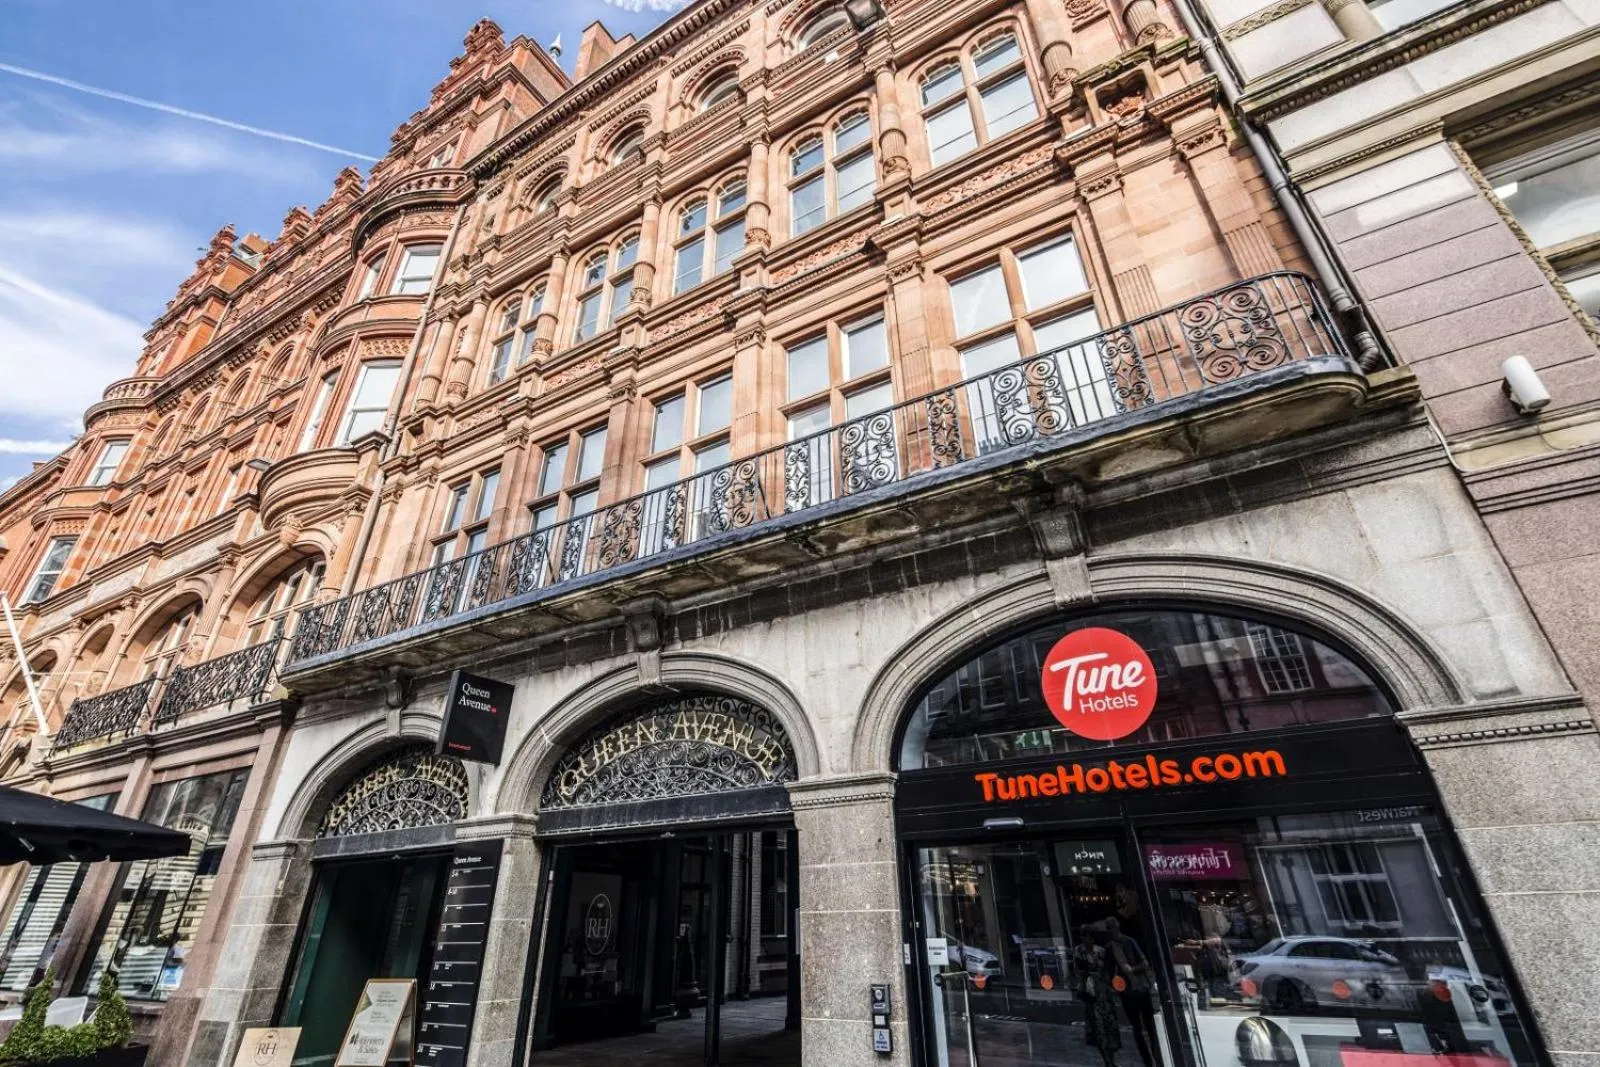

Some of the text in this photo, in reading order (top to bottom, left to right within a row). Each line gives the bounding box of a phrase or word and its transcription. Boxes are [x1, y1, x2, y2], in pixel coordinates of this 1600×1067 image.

[462, 682, 490, 699] Queen
[1049, 652, 1146, 711] Tune
[458, 695, 491, 712] Avenue
[1079, 692, 1139, 714] Hotels
[558, 711, 785, 798] QUEEN AVENUE
[974, 749, 1287, 803] TuneHotels.com
[587, 918, 609, 938] RH
[256, 1042, 277, 1055] RH
